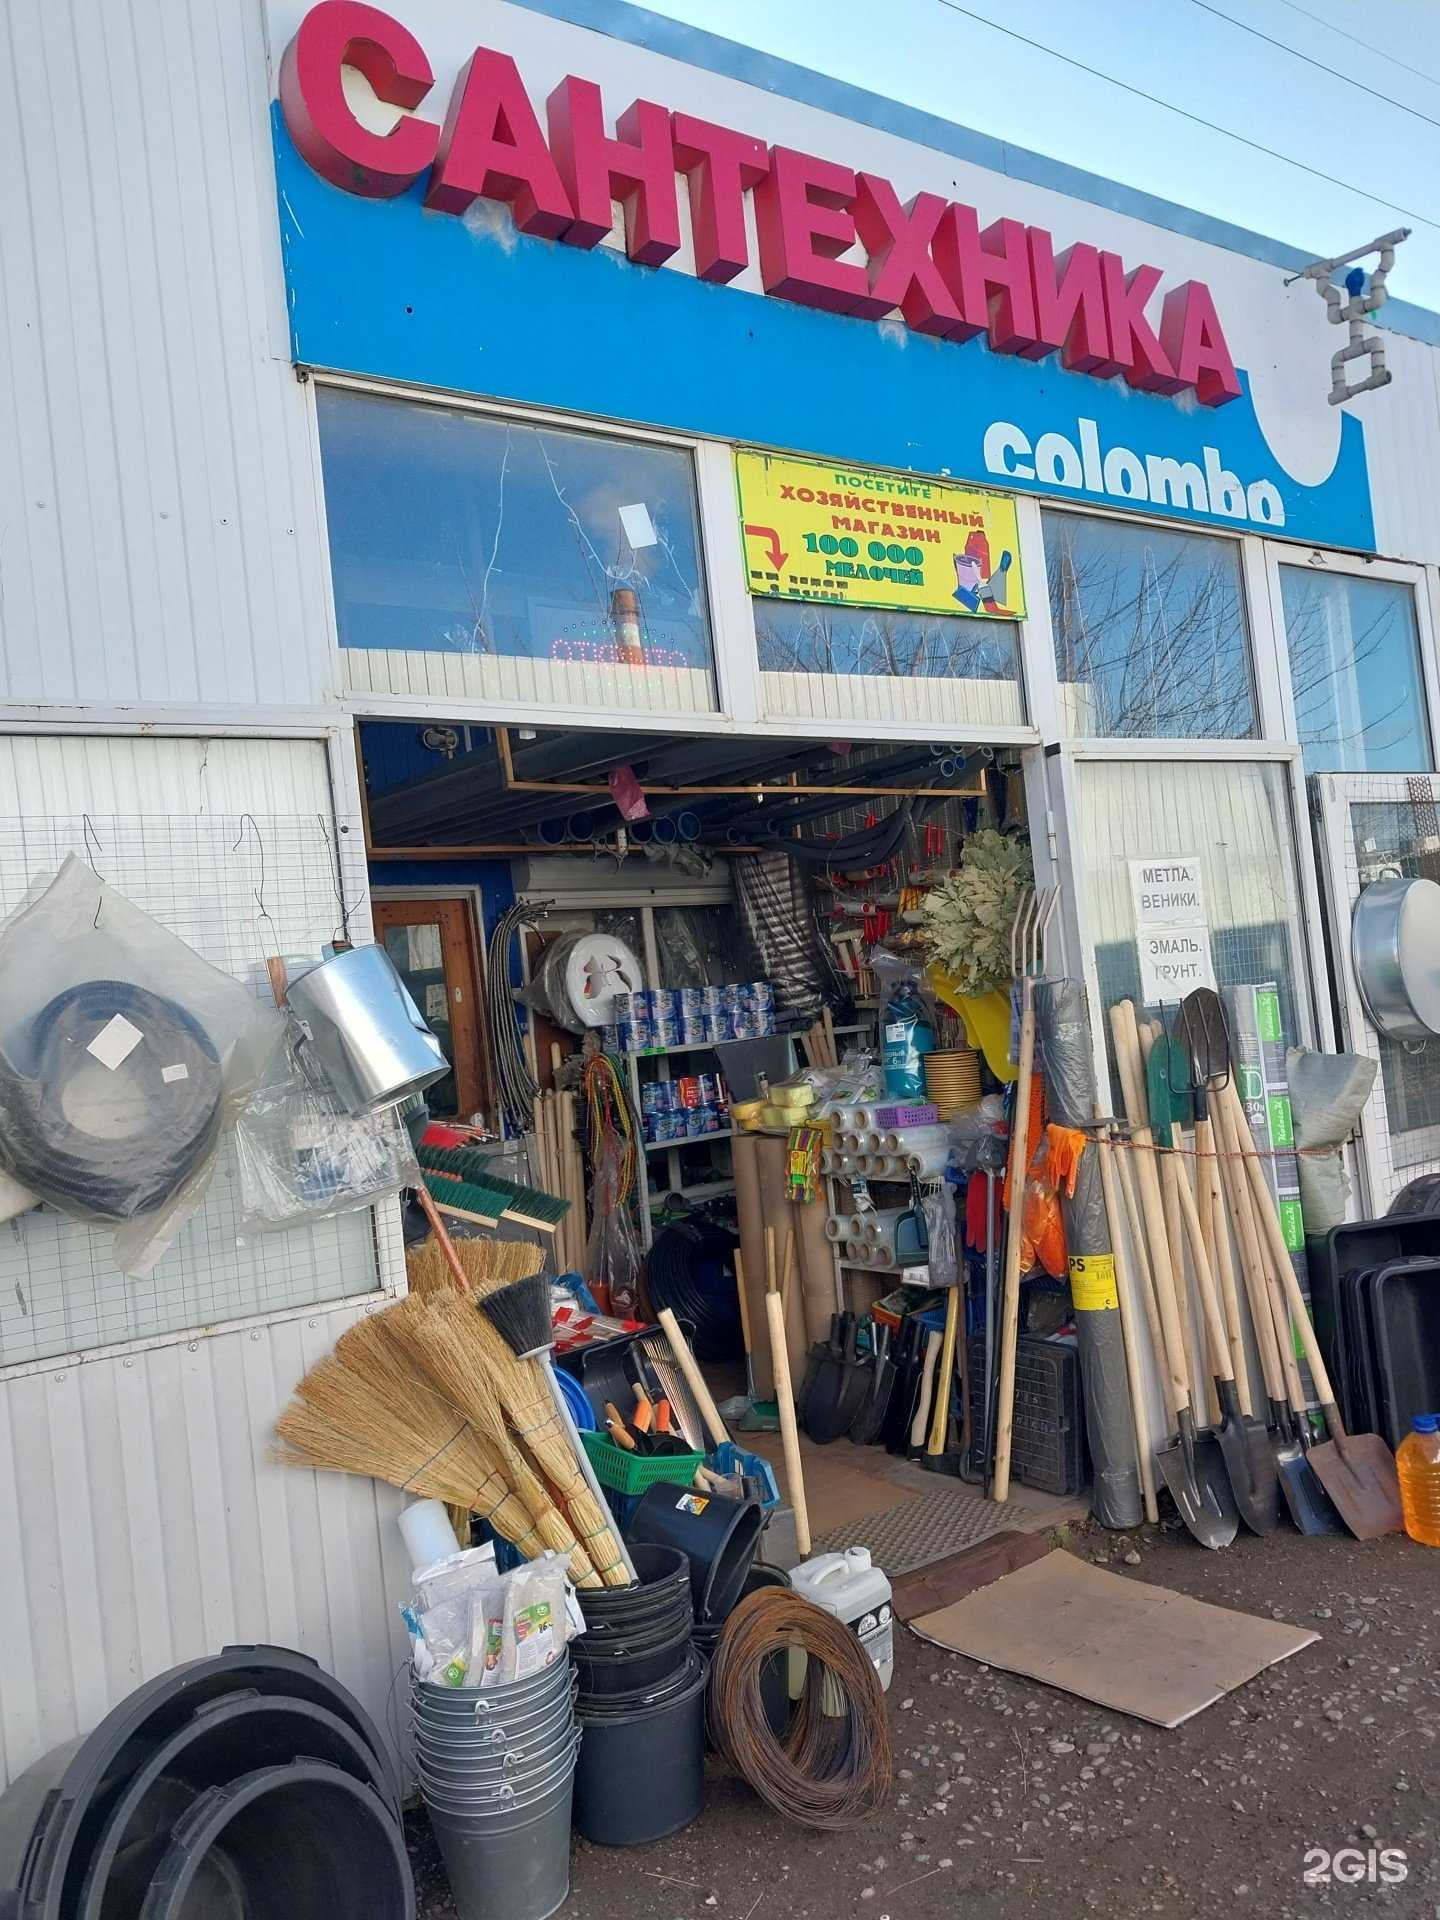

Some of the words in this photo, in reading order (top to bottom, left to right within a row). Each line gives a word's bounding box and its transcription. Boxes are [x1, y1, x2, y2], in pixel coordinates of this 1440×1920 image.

[280, 0, 1243, 407] САНТЕХНИКА
[834, 473, 932, 499] ПОСЕТИТЕ
[983, 417, 1286, 527] colombo
[780, 484, 985, 528] ХОЗЯЙСТВЕННЫЙ
[831, 515, 942, 544] МАГАЗИН
[802, 532, 859, 558] 100
[867, 541, 924, 566] 000
[825, 559, 925, 587] МЕЛОЧЕЙ
[1142, 867, 1194, 884] МЕТЛА.
[1142, 892, 1201, 909] ВЕНИКИ.
[1150, 938, 1203, 955] ЭМАЛЬ.
